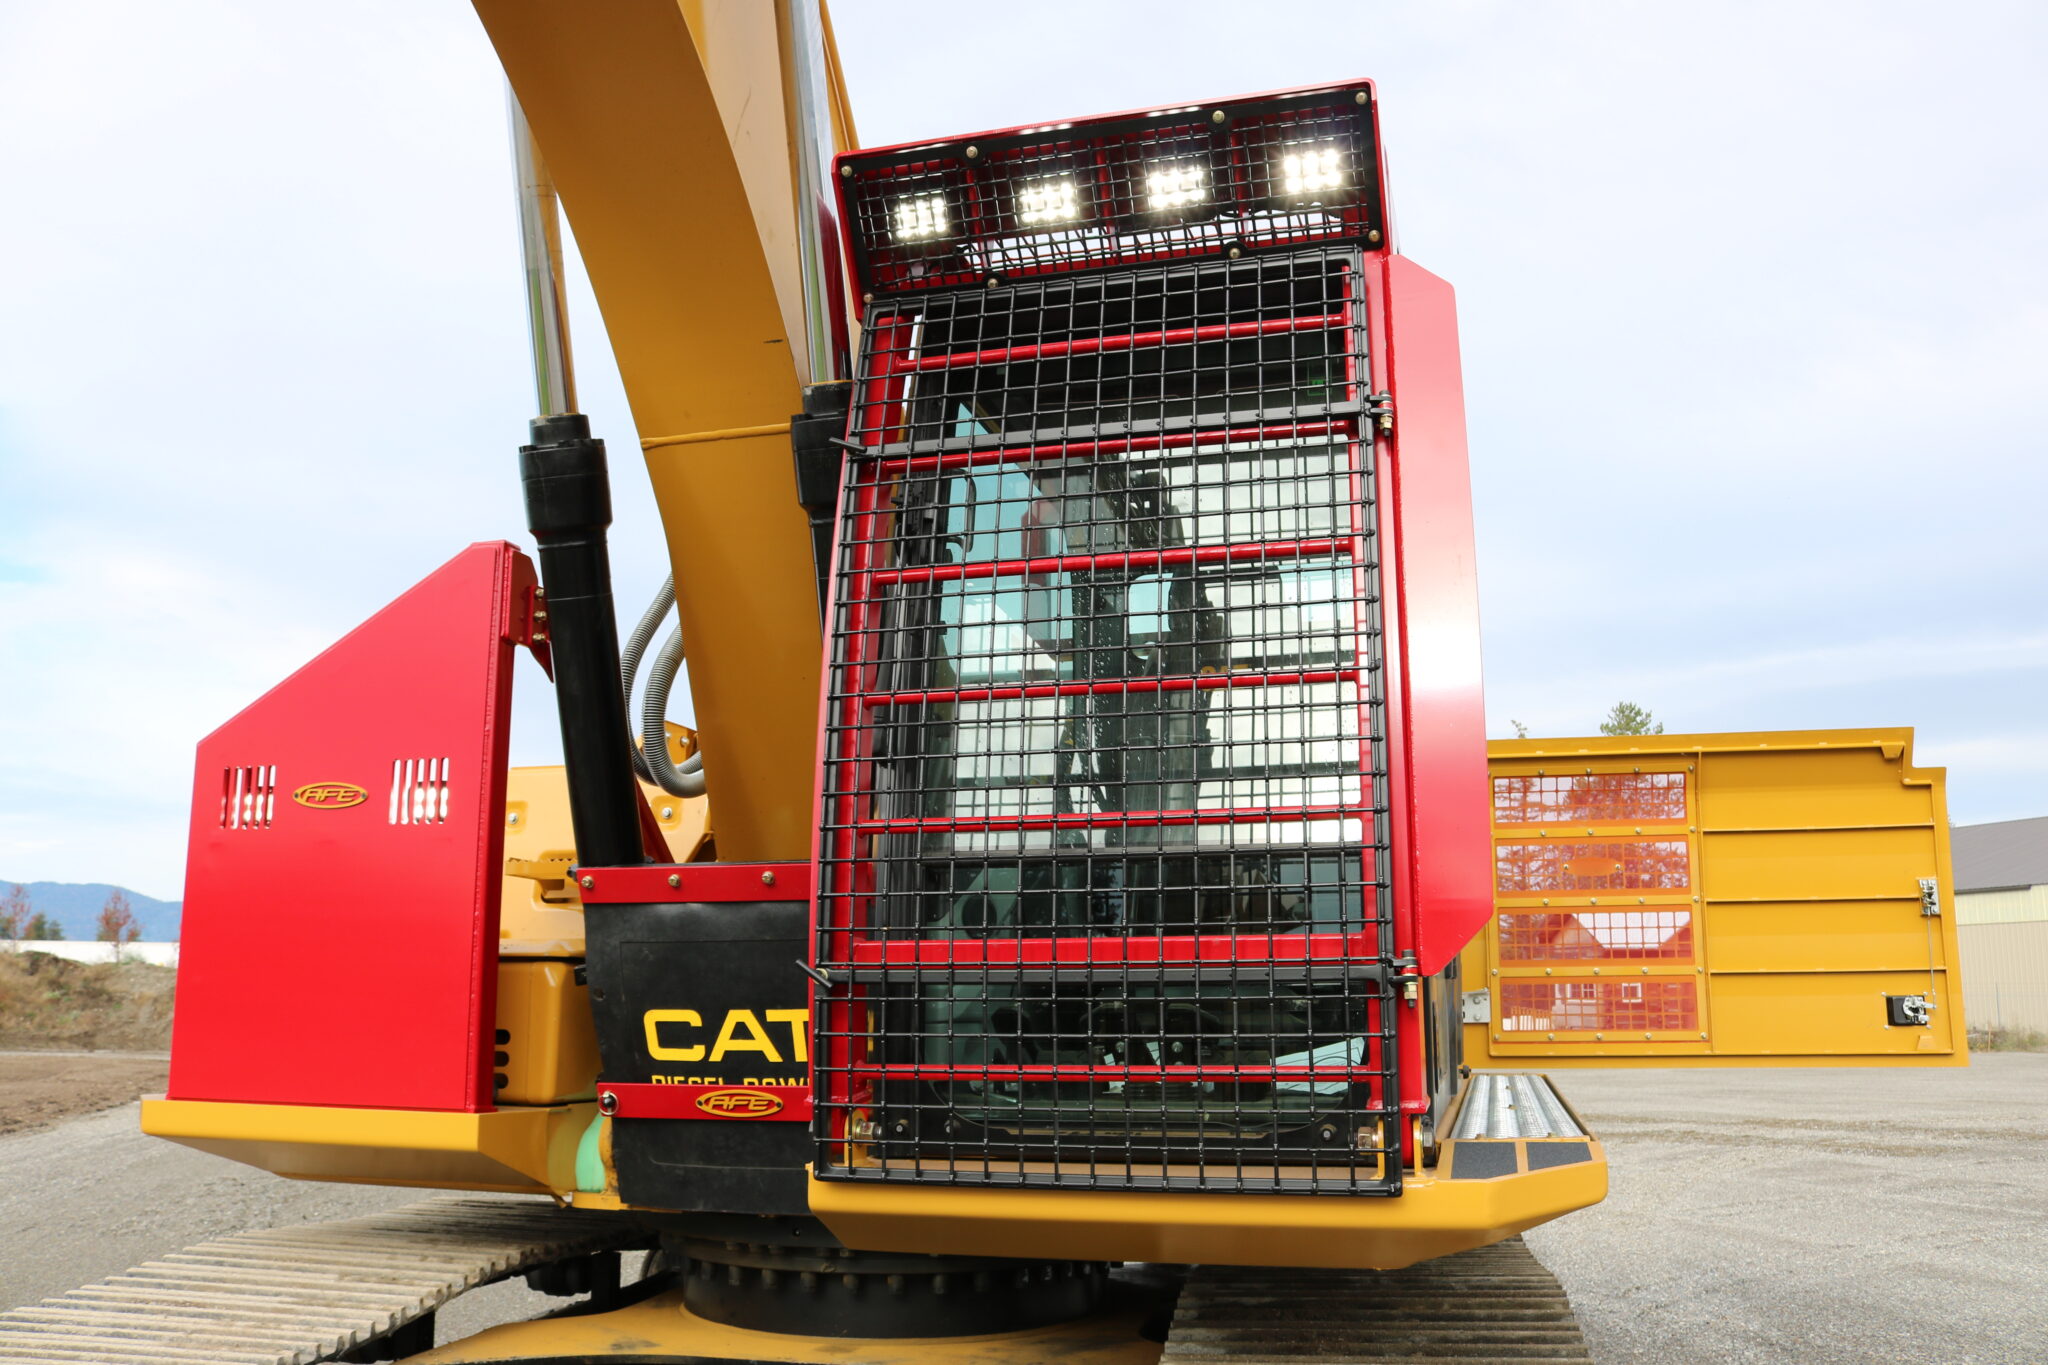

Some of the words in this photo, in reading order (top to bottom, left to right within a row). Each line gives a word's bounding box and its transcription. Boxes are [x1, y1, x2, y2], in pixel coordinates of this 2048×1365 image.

[303, 788, 357, 802] AFE
[644, 1009, 809, 1062] CAT
[708, 1096, 770, 1111] AFE
